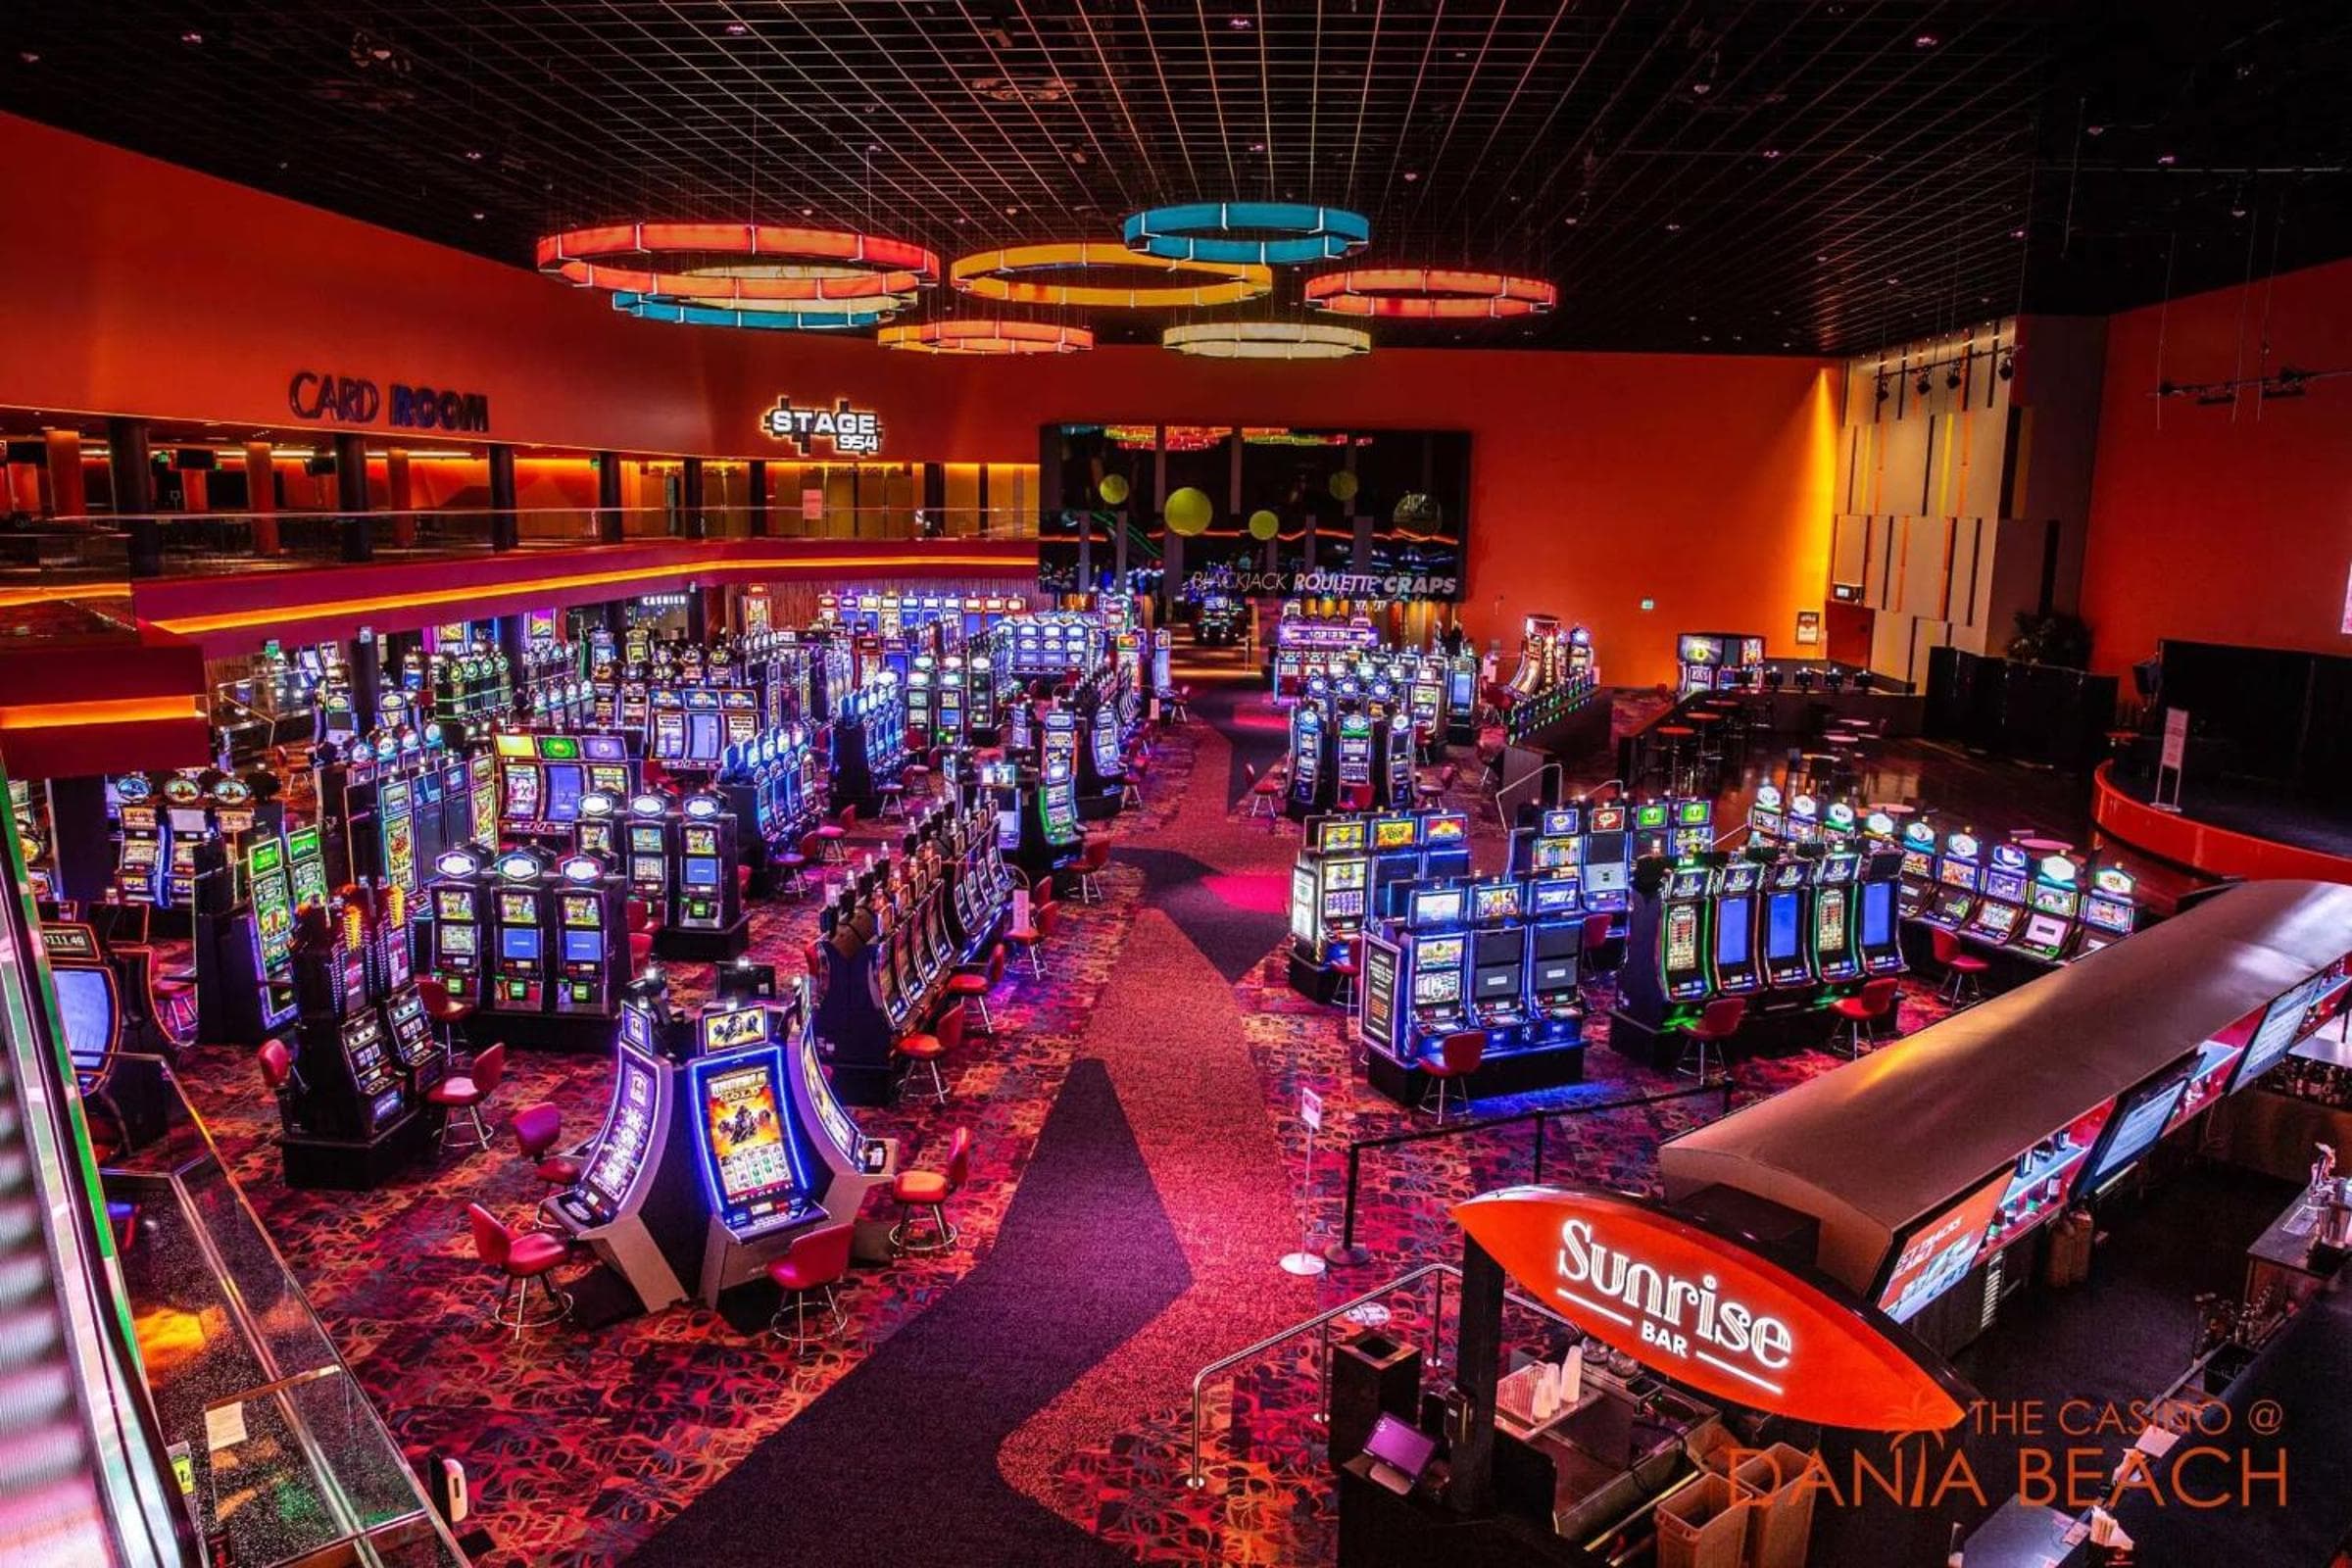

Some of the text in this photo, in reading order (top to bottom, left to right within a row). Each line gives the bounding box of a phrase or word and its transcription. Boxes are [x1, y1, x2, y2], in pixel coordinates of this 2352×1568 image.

[289, 371, 488, 432] CARD ROOM
[772, 411, 876, 434] STAGE
[839, 435, 878, 451] 954
[1192, 571, 1456, 595] BLACKJACK ROULETTE CRAPS
[1558, 1219, 1791, 1368] Sunrise
[1641, 1320, 1689, 1358] BAR
